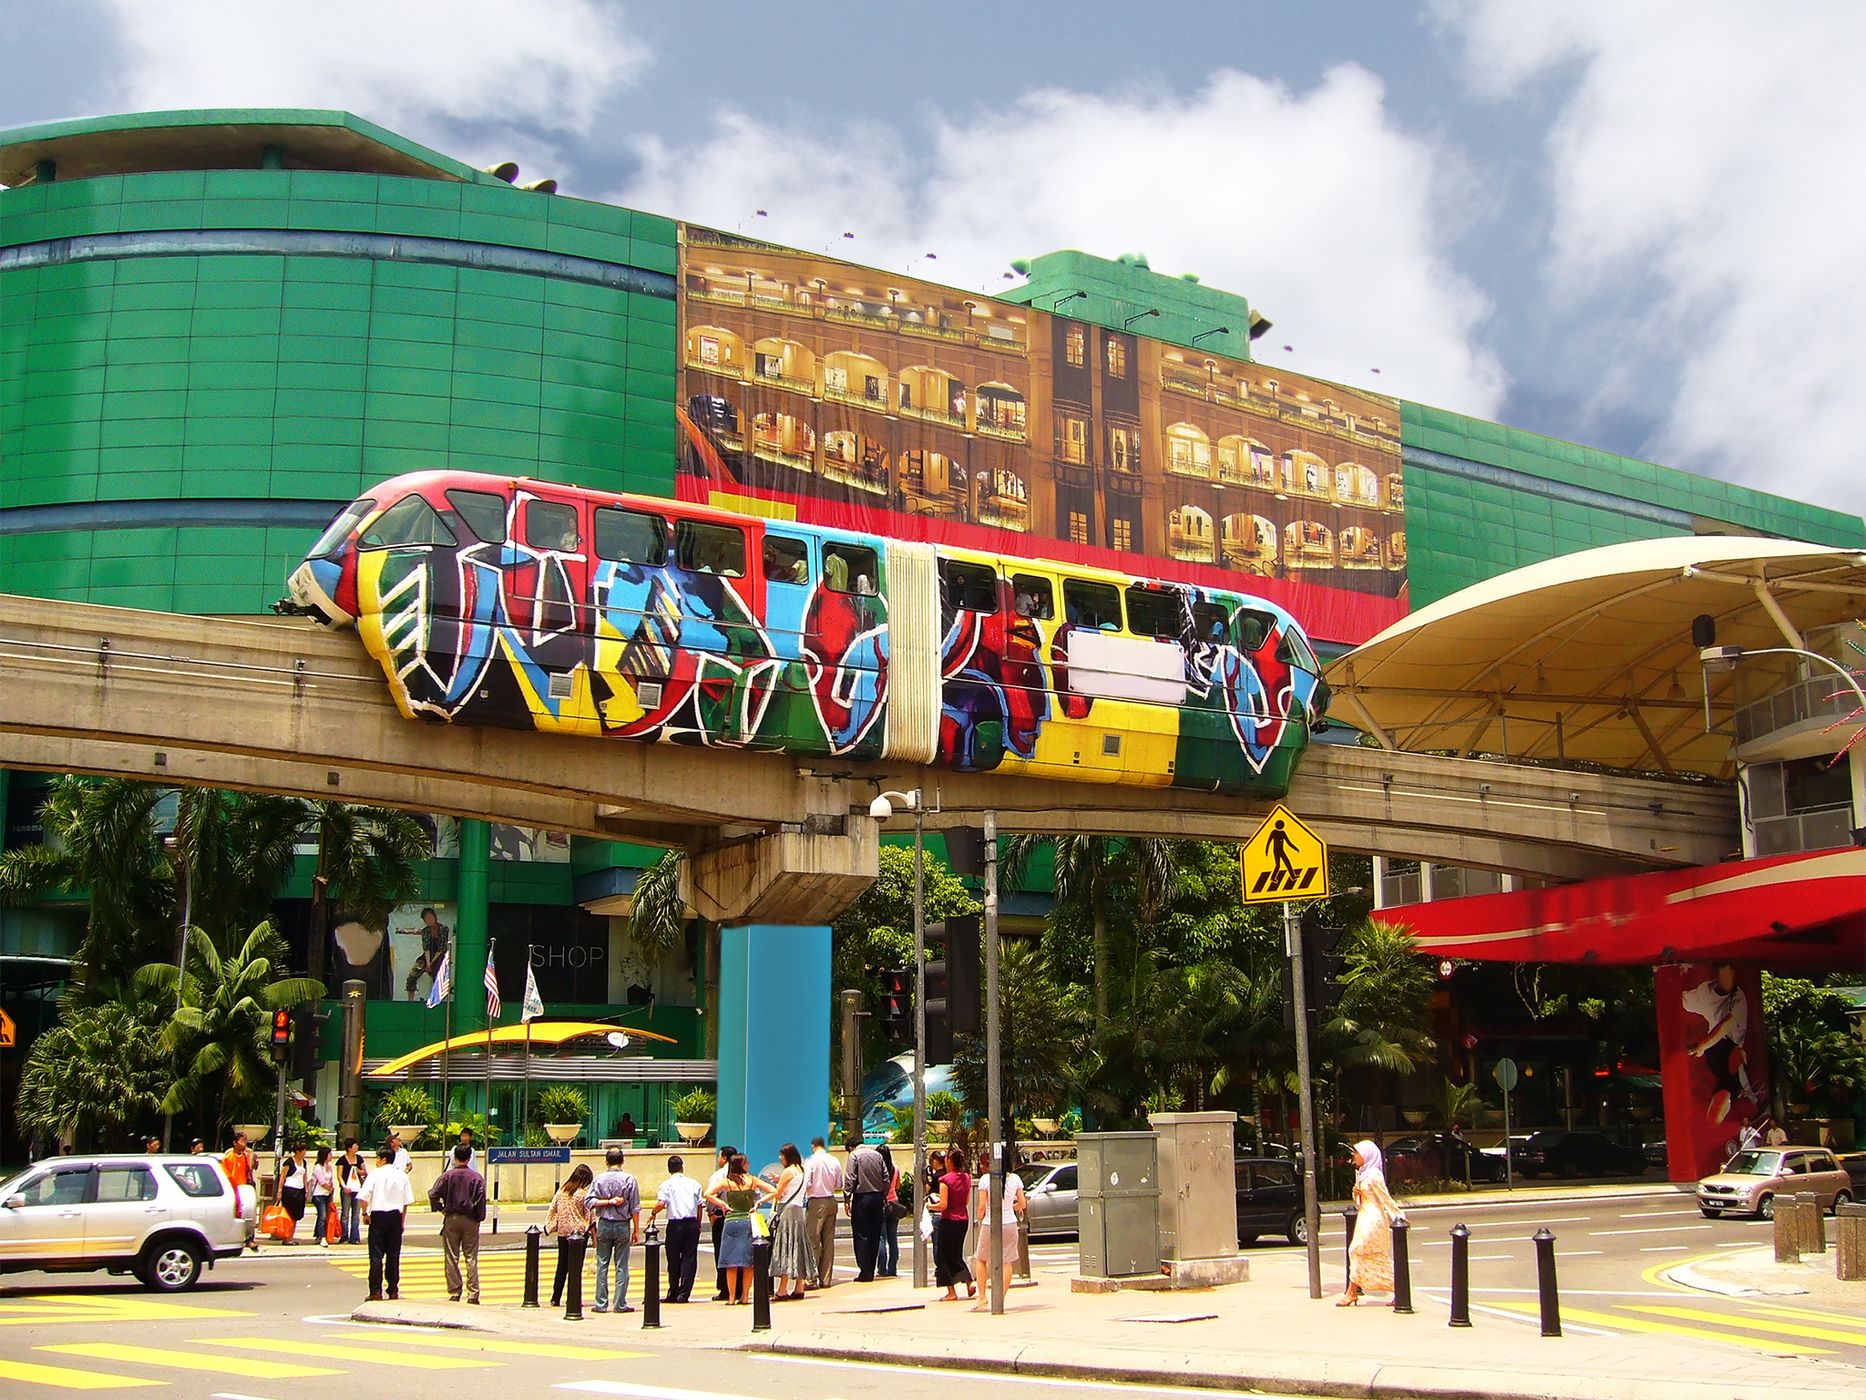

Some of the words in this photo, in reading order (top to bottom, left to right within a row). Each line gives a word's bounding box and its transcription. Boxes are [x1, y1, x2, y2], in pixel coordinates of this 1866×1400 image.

[532, 944, 605, 968] SHOP
[497, 1150, 517, 1158] JALAN
[519, 1150, 541, 1158] SULTAN
[543, 1150, 562, 1158] ISMAIL
